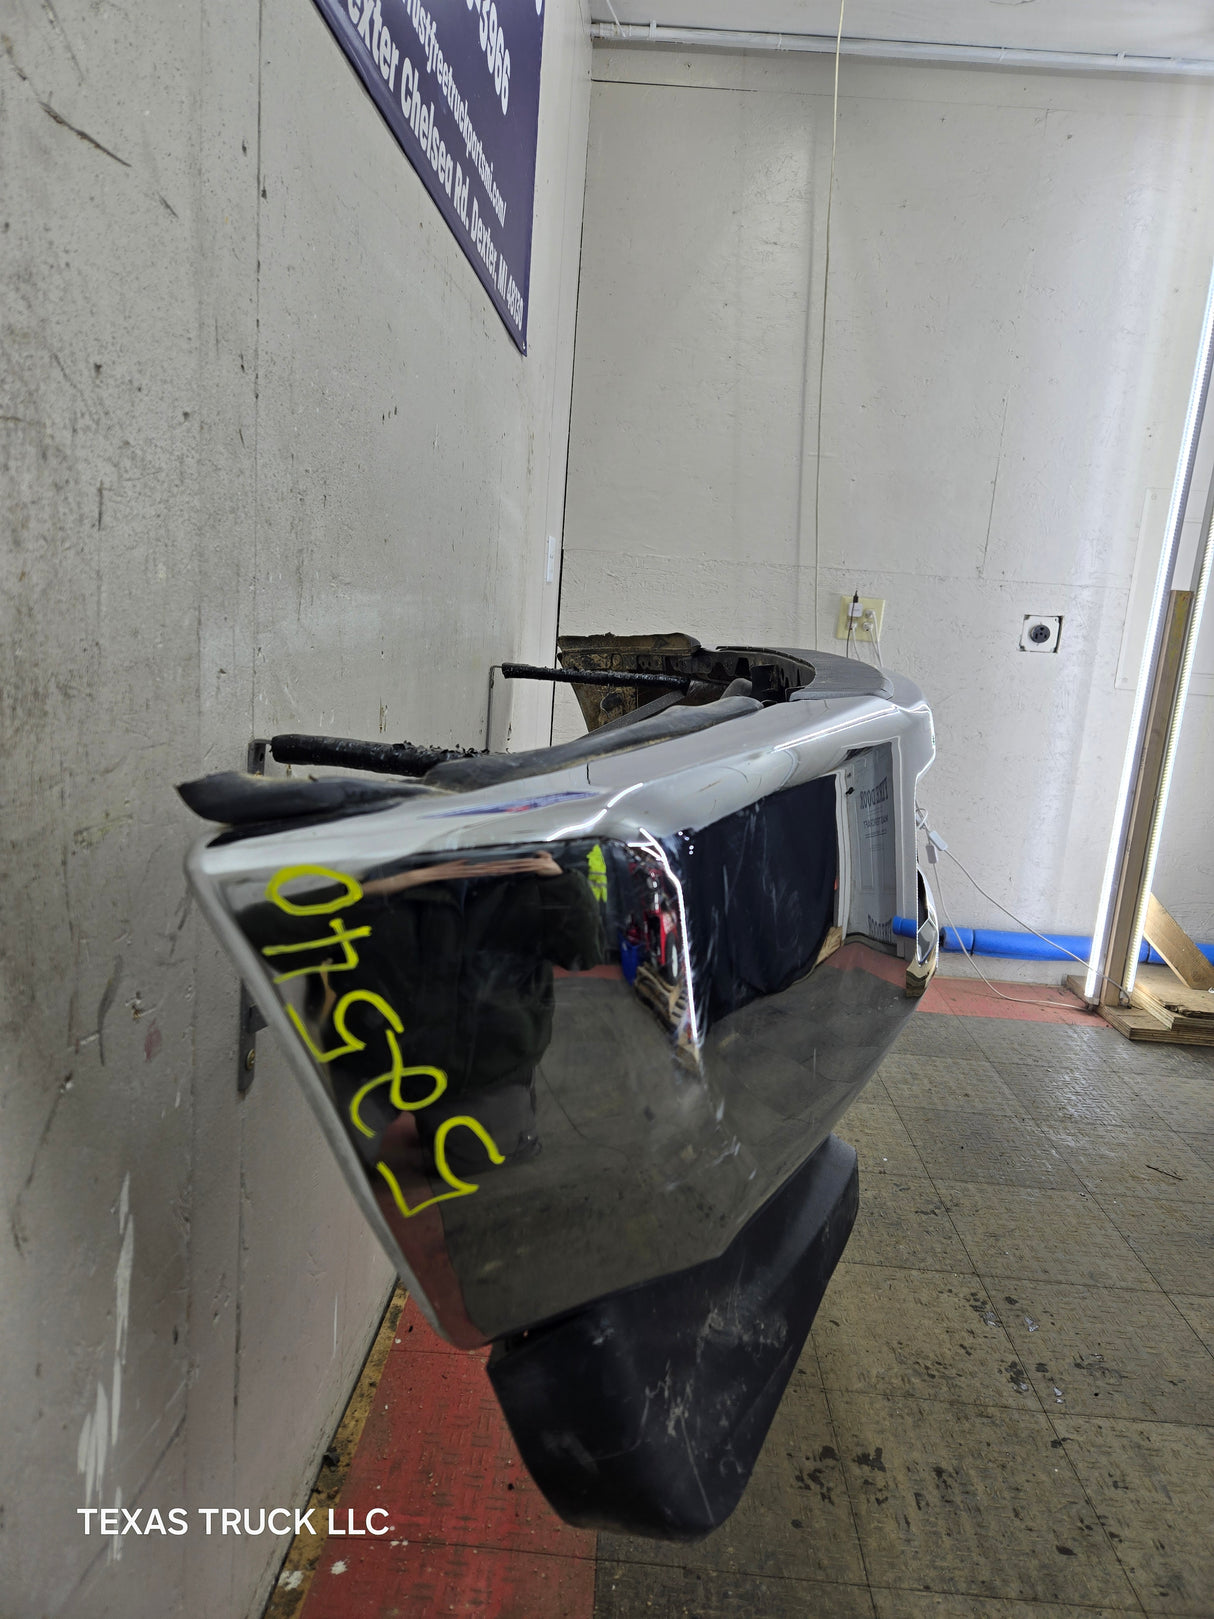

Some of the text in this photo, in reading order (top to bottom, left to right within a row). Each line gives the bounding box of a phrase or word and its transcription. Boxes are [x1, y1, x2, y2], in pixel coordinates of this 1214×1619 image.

[401, 57, 453, 198] Chelsea
[454, 161, 470, 231] Rd.
[470, 196, 498, 290] Dexter,
[498, 253, 508, 300] MI
[262, 863, 507, 1219] 52540
